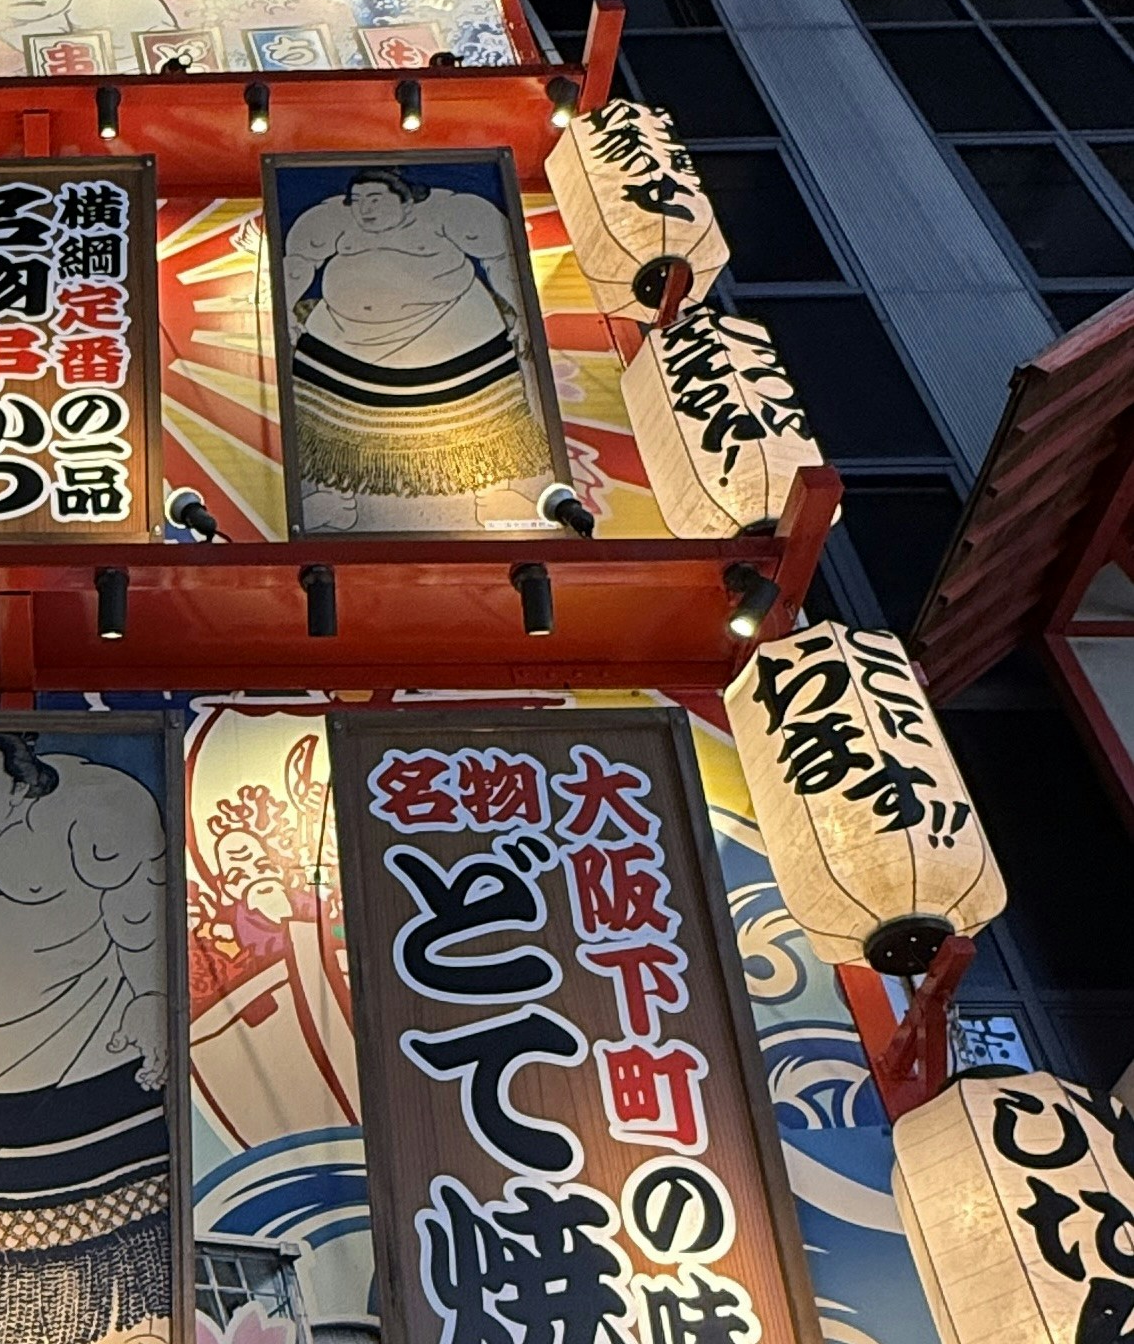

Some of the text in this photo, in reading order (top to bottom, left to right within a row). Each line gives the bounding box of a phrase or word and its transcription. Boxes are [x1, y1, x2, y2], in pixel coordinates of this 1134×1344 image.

[54, 184, 130, 517] 横綱定番の一品
[376, 756, 543, 828] 名物
